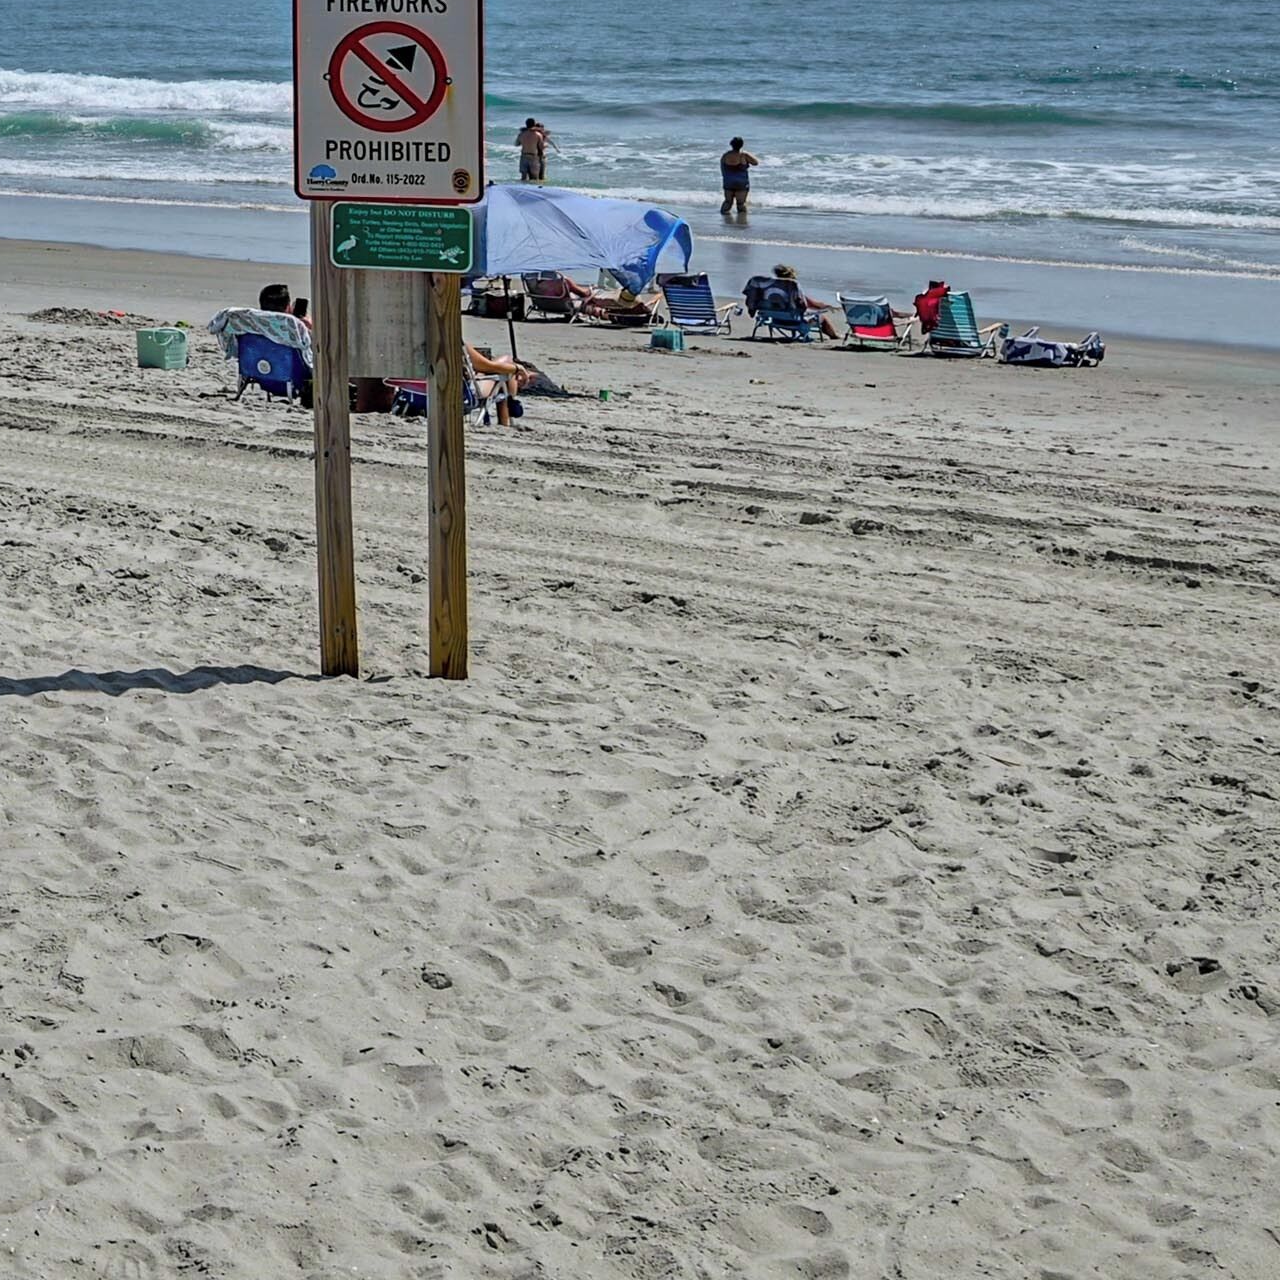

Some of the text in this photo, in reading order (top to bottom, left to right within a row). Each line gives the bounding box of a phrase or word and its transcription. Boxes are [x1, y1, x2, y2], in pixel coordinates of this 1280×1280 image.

[325, 140, 451, 162] PROHIBITED
[386, 173, 425, 185] 115-2022
[398, 209, 417, 217] NOT
[418, 210, 455, 219] DISTURB
